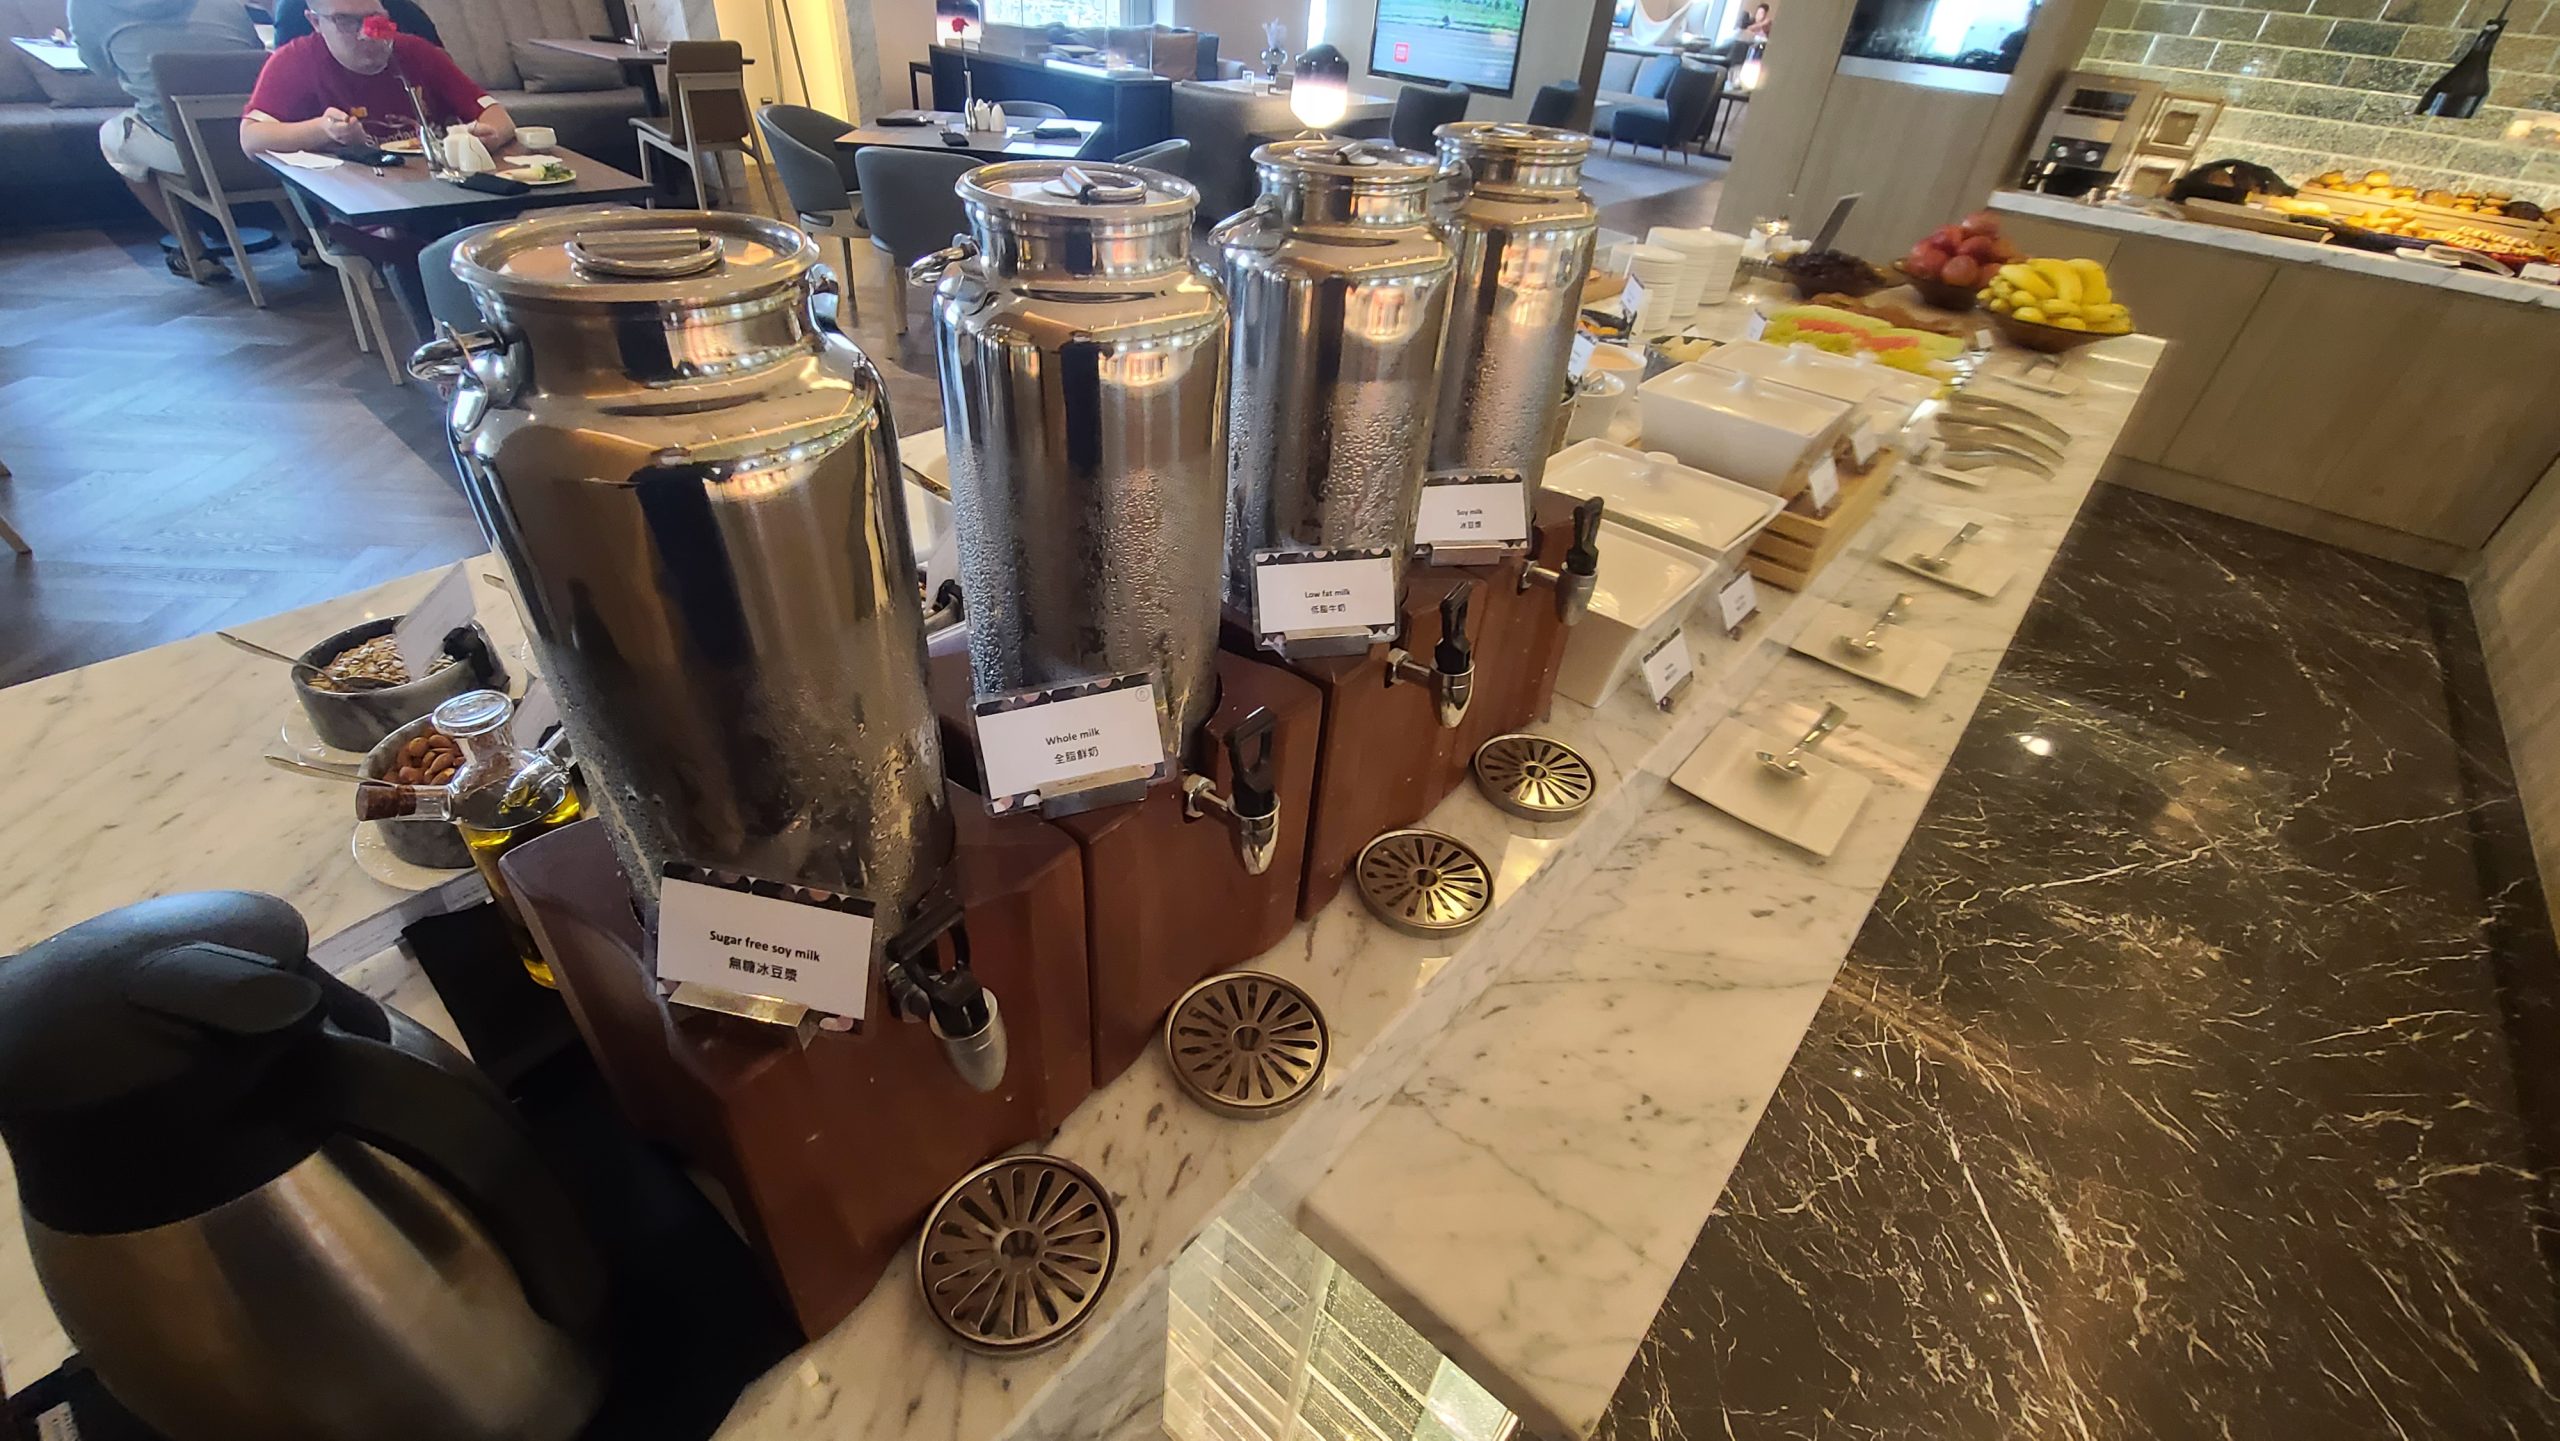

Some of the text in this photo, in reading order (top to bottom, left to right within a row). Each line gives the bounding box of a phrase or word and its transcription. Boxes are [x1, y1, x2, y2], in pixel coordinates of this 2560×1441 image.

[1304, 588, 1350, 599] Low fat milk
[1310, 603, 1346, 614] 低脂牛奶
[1045, 727, 1100, 746] Whole milk
[1053, 745, 1099, 765] 全脂鮮奶
[709, 930, 821, 963] Sugar free soy milk
[729, 956, 798, 983] 無糖冰豆漿
